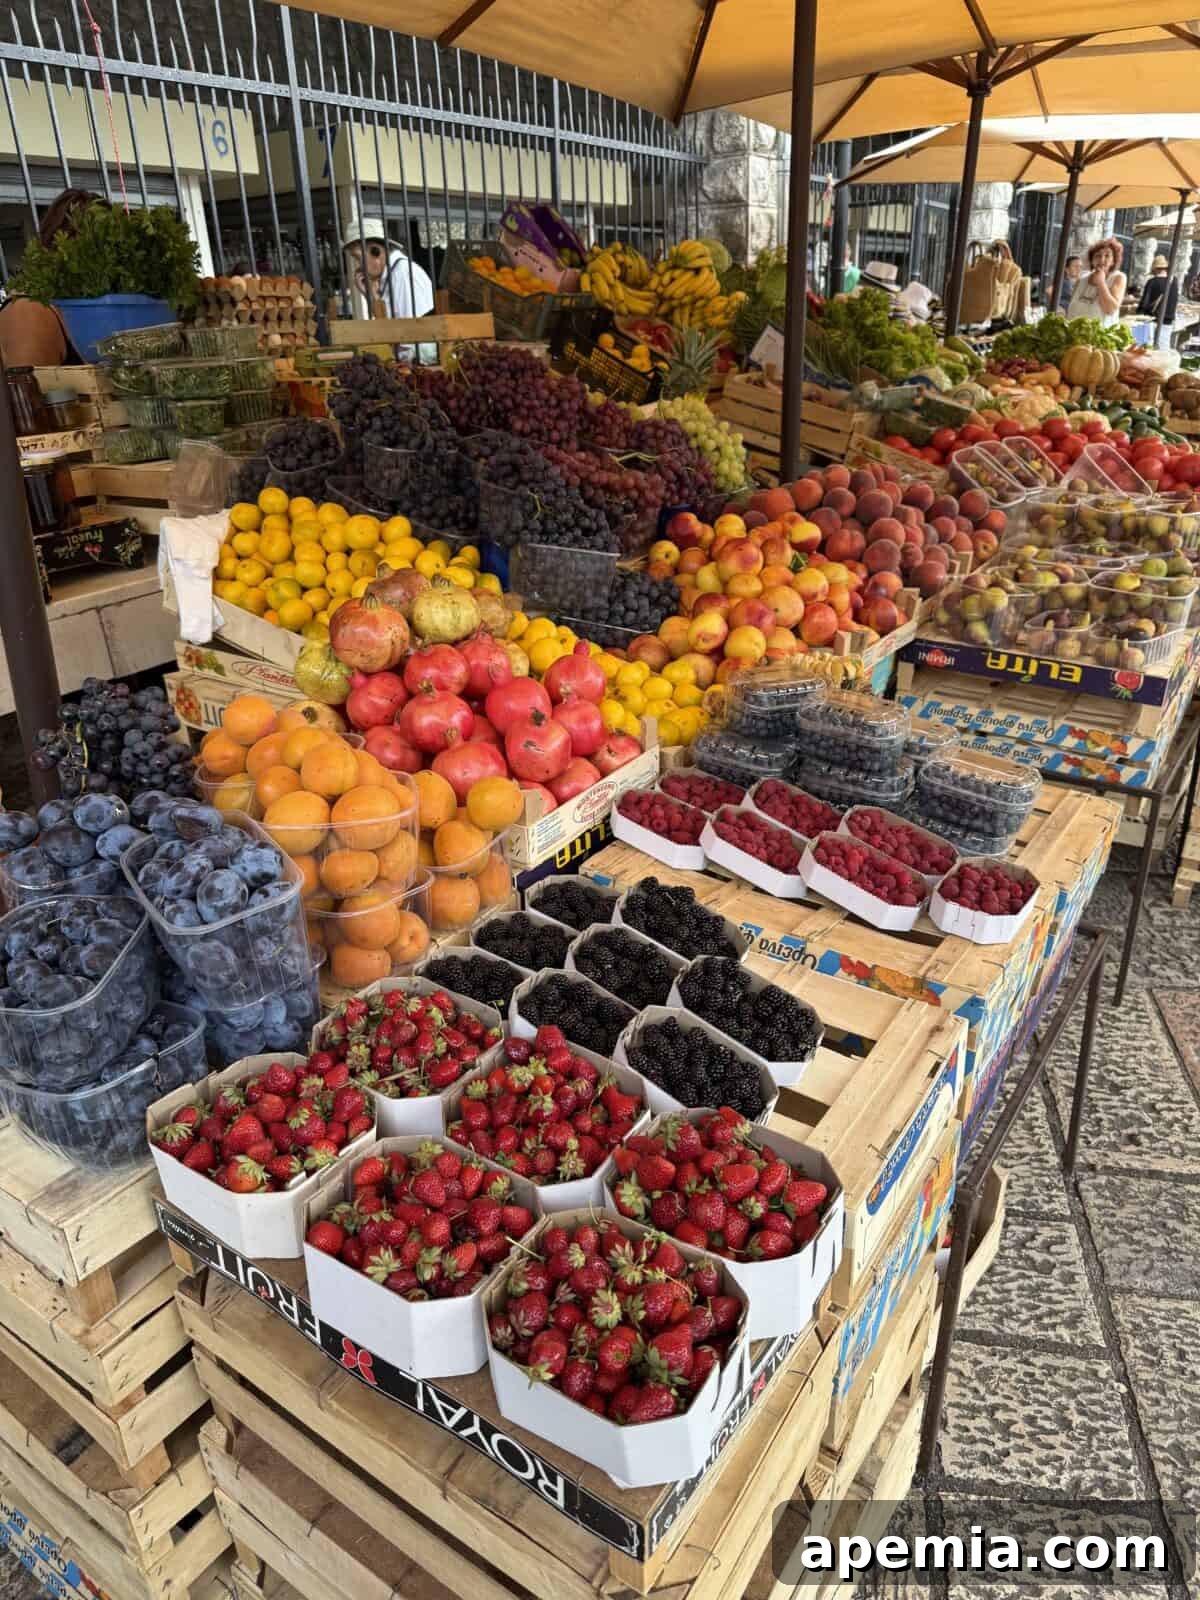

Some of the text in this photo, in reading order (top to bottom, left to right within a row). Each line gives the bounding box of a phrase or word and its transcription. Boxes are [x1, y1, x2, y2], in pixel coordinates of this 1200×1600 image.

[211, 119, 229, 158] 6
[917, 650, 955, 666] IRMINI
[985, 651, 1083, 684] ELITA
[554, 822, 606, 870] LITA
[758, 937, 818, 970] Ορεινά
[210, 1243, 566, 1511] ROYAL FRUIT
